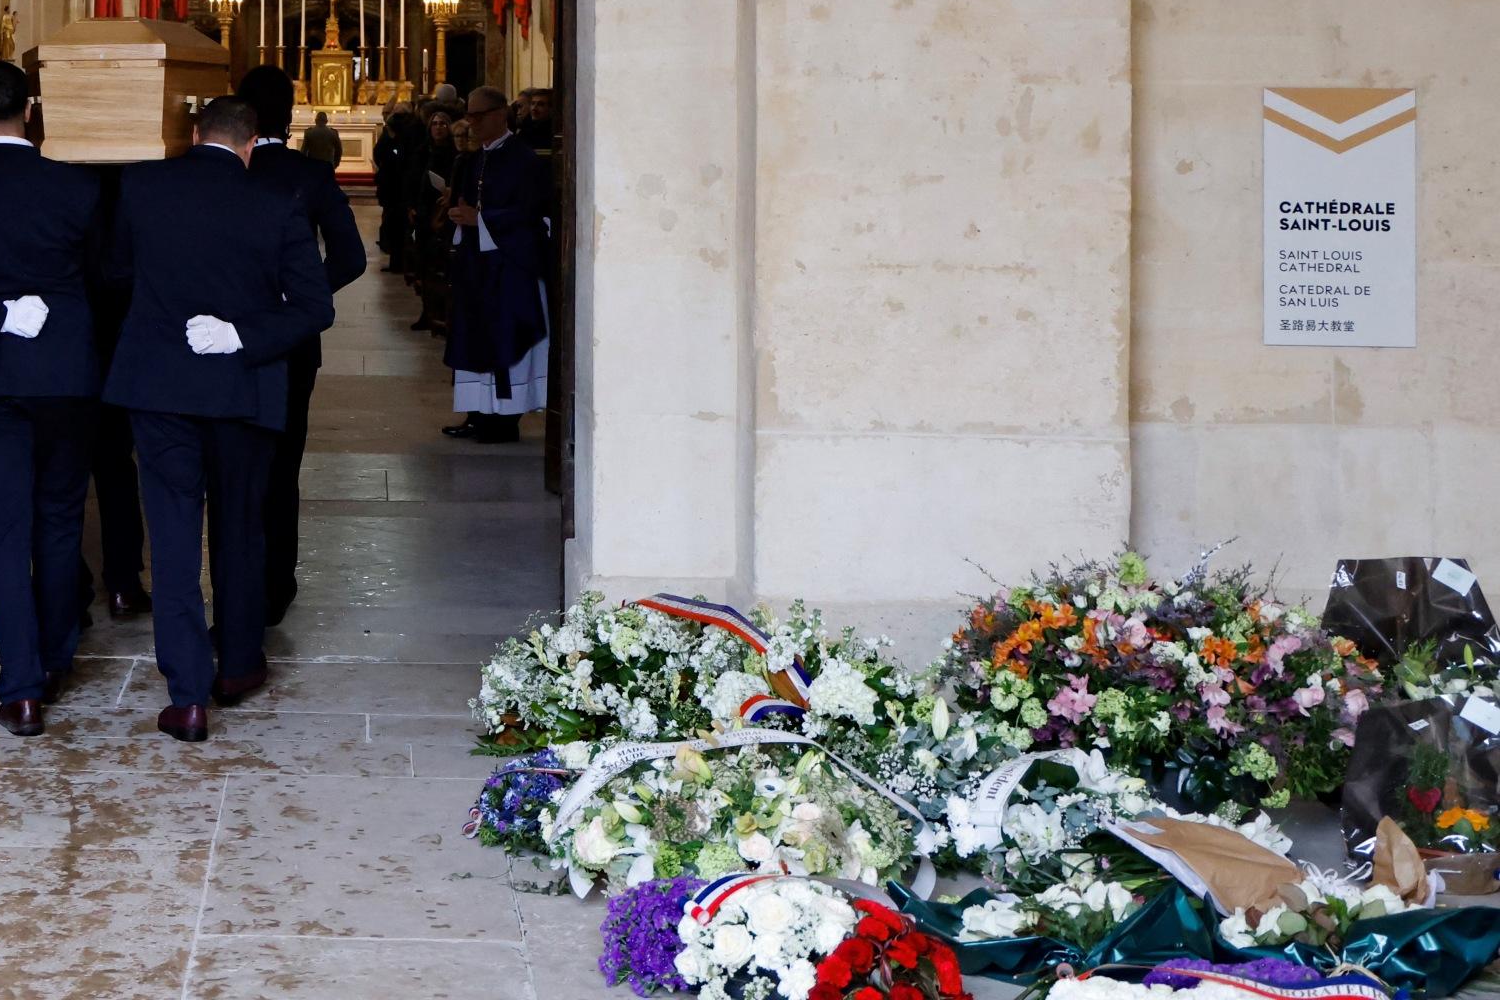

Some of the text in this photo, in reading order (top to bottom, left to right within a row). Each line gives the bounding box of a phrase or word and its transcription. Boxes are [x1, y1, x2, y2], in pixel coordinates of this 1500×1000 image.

[1279, 199, 1395, 215] CATHÉDRALE
[1279, 218, 1391, 232] SAINT-LOUIS
[1279, 250, 1363, 261] SAINT LOUIS
[1279, 262, 1361, 273] CATHEDRAL
[1279, 285, 1371, 296] CATEDRAL DE
[1279, 297, 1339, 308] SAN LUIS
[1279, 319, 1355, 332] 圣路易大教堂
